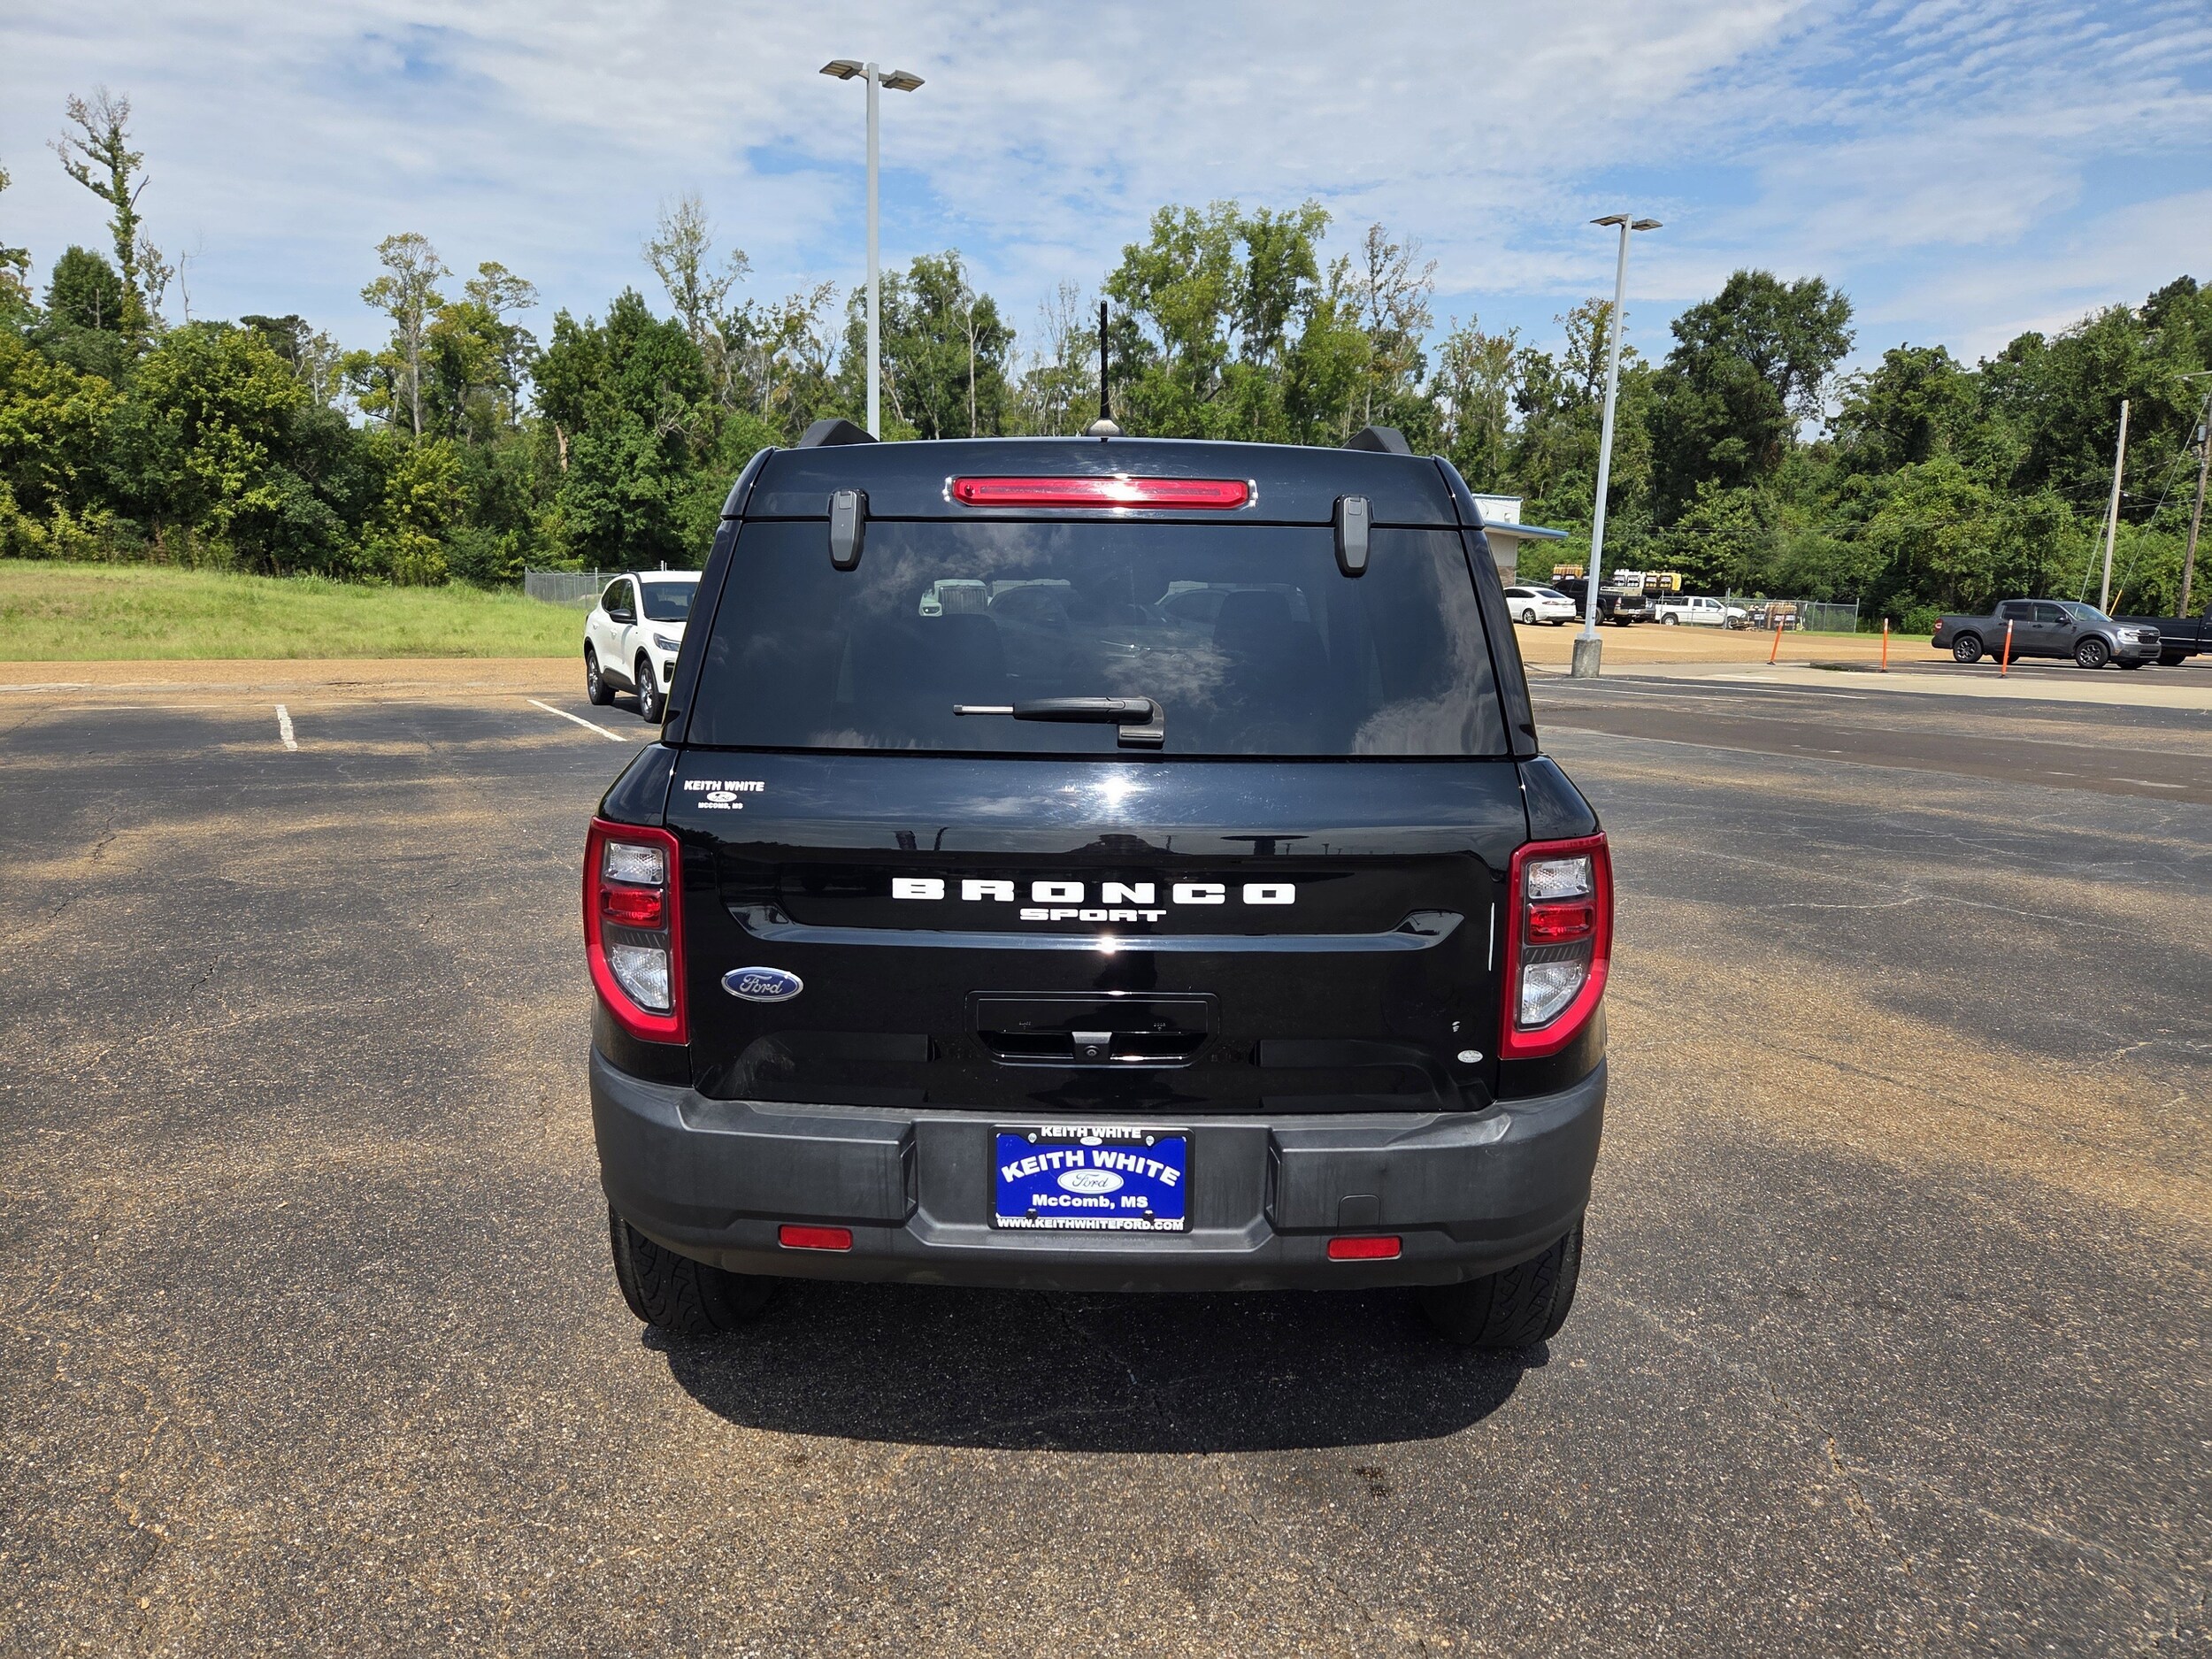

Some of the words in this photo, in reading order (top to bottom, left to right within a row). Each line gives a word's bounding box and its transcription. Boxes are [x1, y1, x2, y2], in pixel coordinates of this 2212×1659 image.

[684, 780, 722, 791] KEITH
[724, 780, 765, 792] WHITE
[892, 877, 1296, 905] BRONCO
[1019, 908, 1167, 922] SPORT
[739, 973, 784, 994] Ford
[1041, 1126, 1087, 1138] KEITH
[1091, 1126, 1142, 1139] WHITE
[1001, 1150, 1085, 1183] KEITH
[1092, 1150, 1181, 1187] WHITE
[1071, 1173, 1108, 1187] Ford
[1032, 1194, 1116, 1210] McComb,
[1120, 1195, 1148, 1209] MS
[996, 1217, 1184, 1231] WWW.KEITHWHITEFORD.COM
